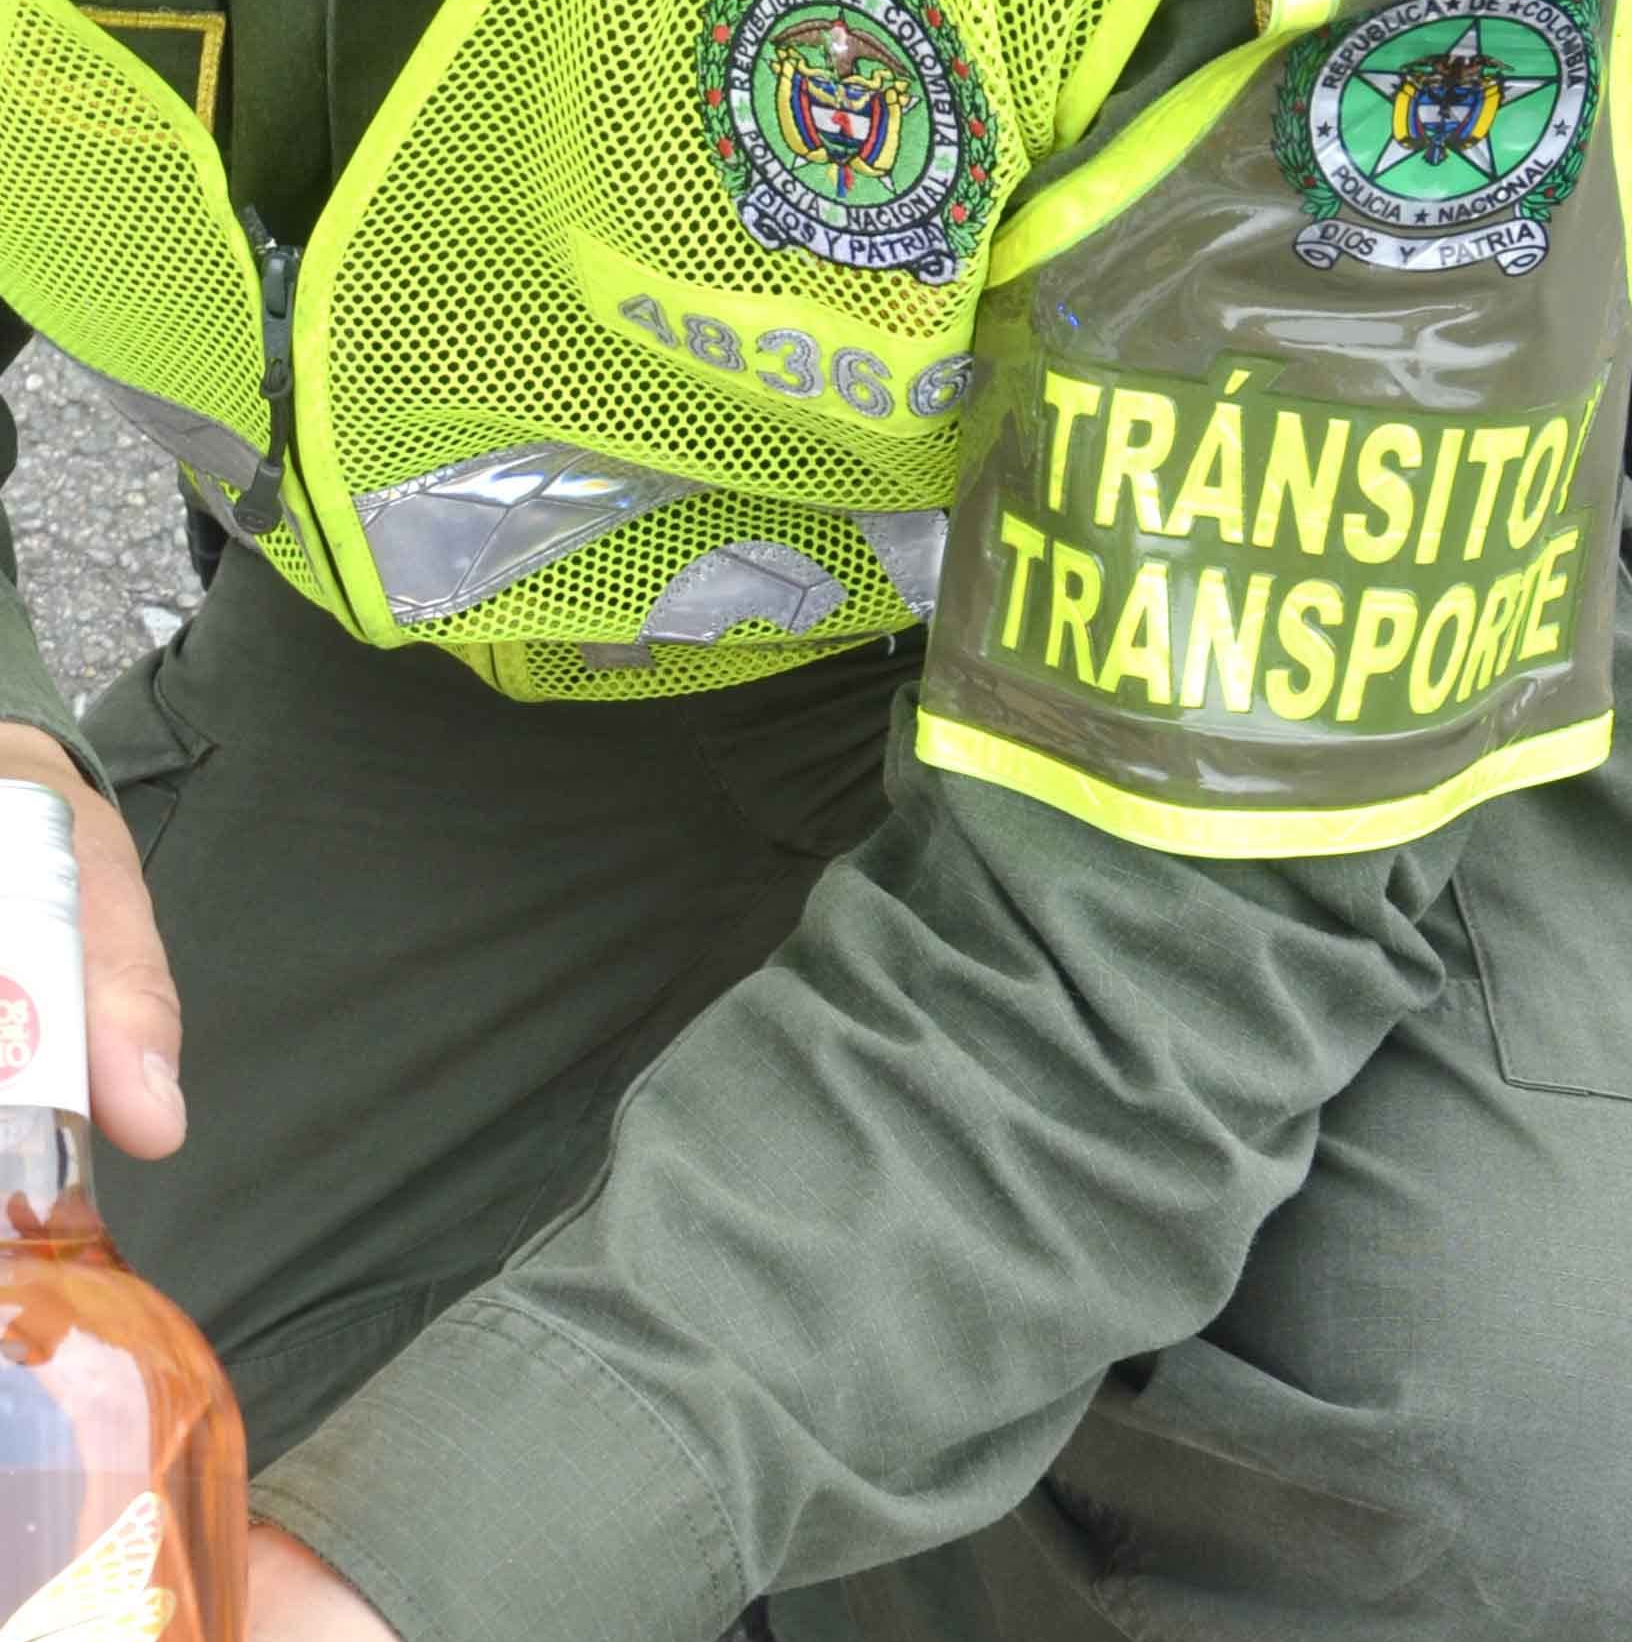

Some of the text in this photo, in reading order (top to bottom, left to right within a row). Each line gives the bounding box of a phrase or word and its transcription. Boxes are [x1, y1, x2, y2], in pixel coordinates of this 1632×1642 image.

[883, 5, 958, 147] COLOMBIA
[1522, 0, 1586, 88] COLOMBIA
[746, 130, 950, 232] POLICIA NACIONAL
[1331, 156, 1555, 225] POLICIA NACIONAL
[754, 190, 946, 263] DIOS Y PATRIA
[1320, 221, 1537, 267] DIOS Y PATRIA
[1000, 513, 1580, 724] TRANSPORTE
